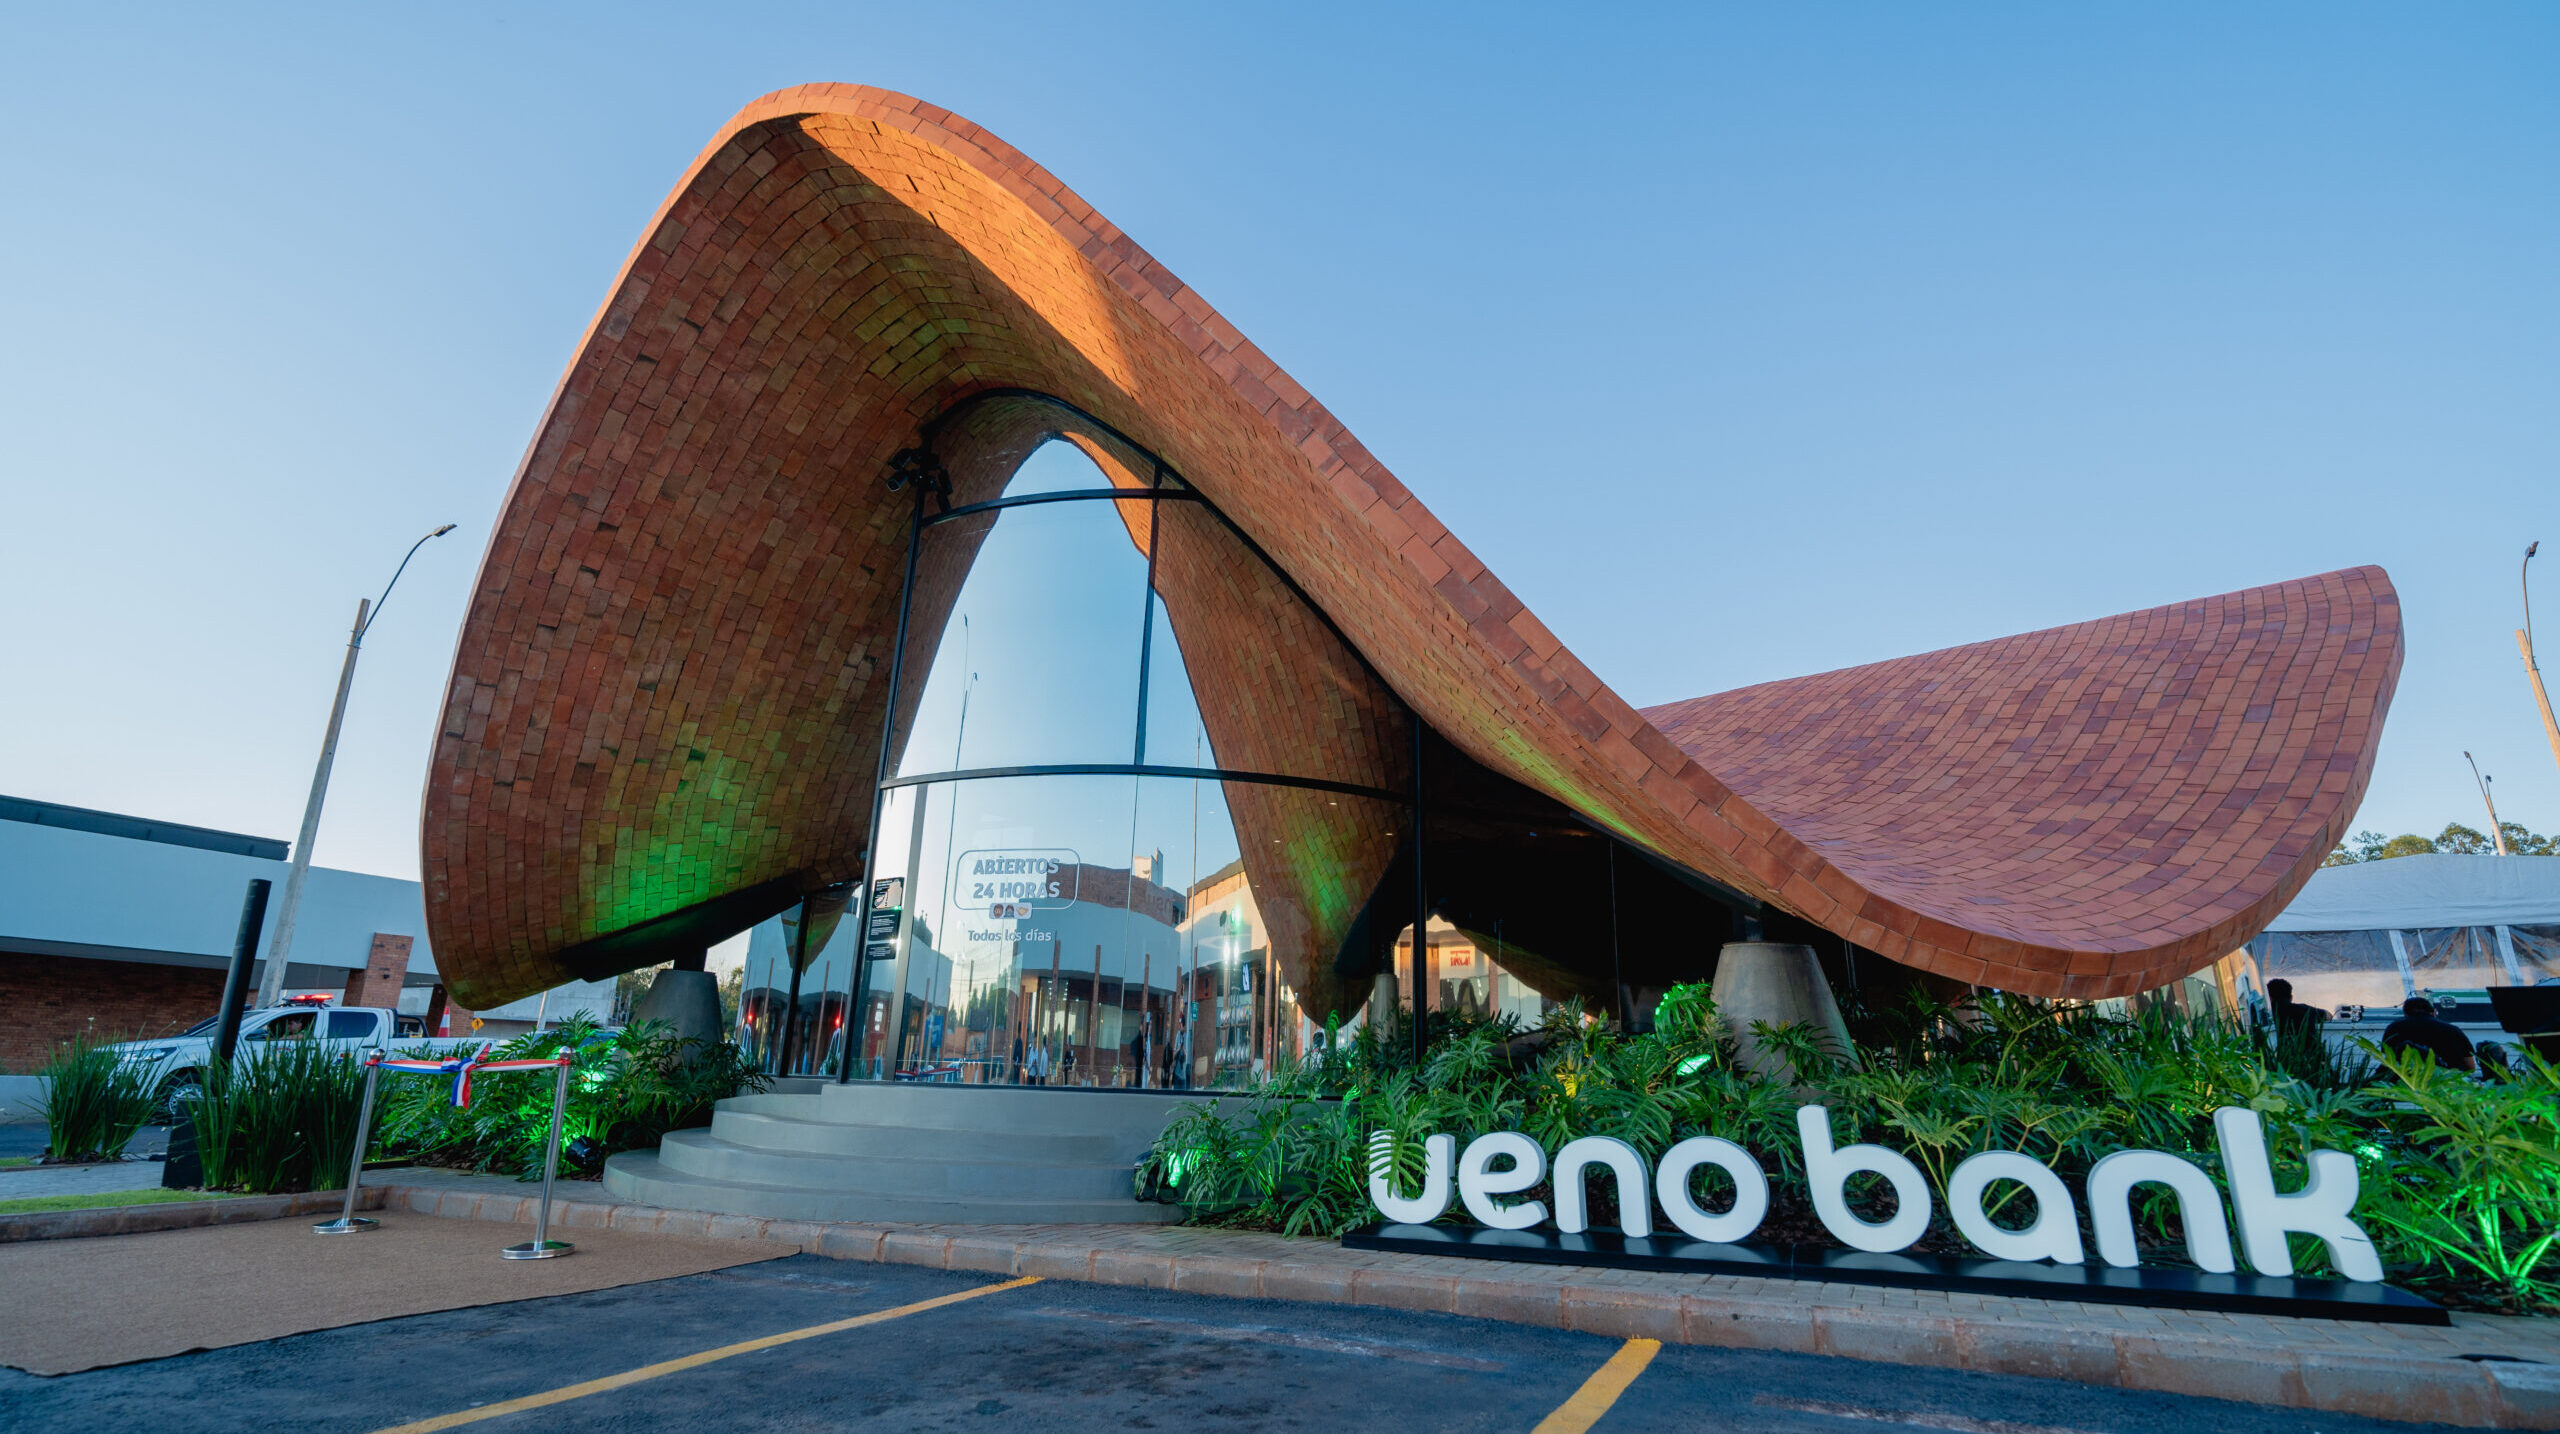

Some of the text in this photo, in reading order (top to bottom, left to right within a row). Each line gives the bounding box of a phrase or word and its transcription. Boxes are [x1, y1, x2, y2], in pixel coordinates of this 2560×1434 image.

[972, 858, 1060, 875] ABIERTOS
[973, 881, 1060, 899] 24 HORAS
[968, 928, 1052, 942] Todos los días
[1368, 1104, 2385, 1282] ueno bank
